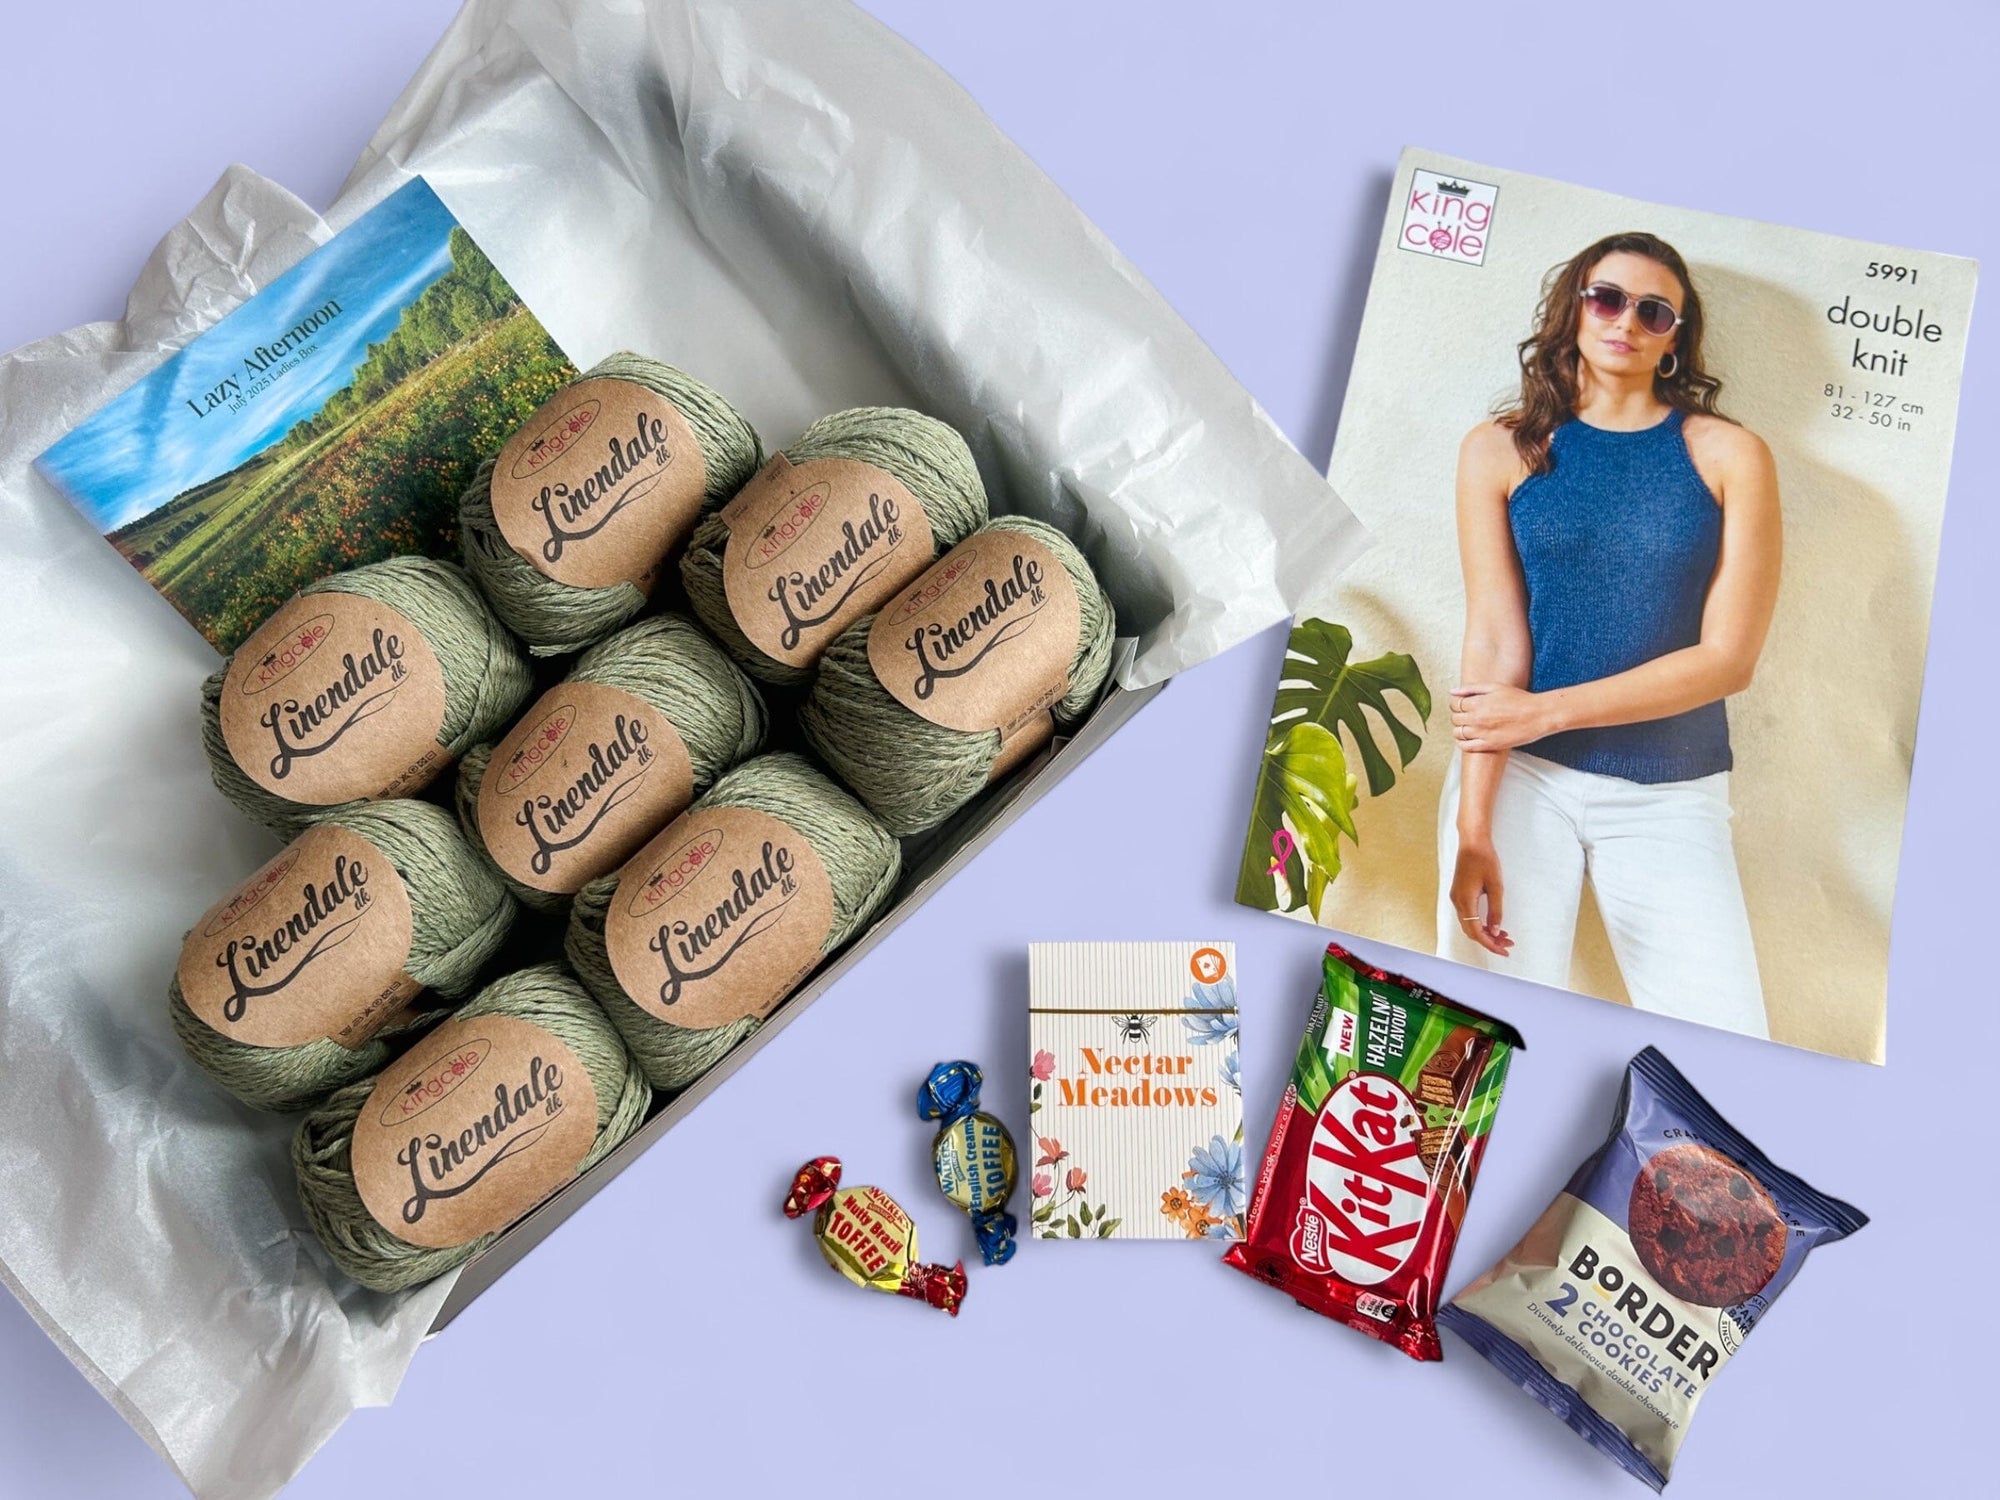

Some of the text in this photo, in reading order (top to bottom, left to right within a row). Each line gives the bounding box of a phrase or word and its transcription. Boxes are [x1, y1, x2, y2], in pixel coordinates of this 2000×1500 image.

[1865, 262, 1918, 285] 5991
[185, 300, 344, 419] Lazy Afternoon
[1827, 295, 1942, 343] double
[1852, 337, 1908, 377] knit
[228, 342, 320, 416] July 2025 Ladies Box
[1823, 383, 1844, 399] 81
[1864, 391, 1897, 408] 127
[1901, 401, 1924, 415] cm
[1830, 403, 1854, 420] 32
[1868, 411, 1893, 428] 50
[1897, 417, 1911, 432] in
[532, 412, 668, 563] Linendale
[768, 493, 900, 650] Linendale
[905, 554, 1044, 700] Linendale
[260, 627, 405, 780] Linendale
[515, 713, 648, 875] Linendale
[216, 855, 368, 1022] Linendale
[649, 841, 794, 1006] Linendale
[1078, 1046, 1194, 1076] Nectar
[1339, 1013, 1354, 1053] NEW
[1057, 1077, 1219, 1108] Meadows
[397, 1056, 563, 1224] Linendale
[982, 1125, 1008, 1198] TOFFEE
[1248, 1196, 1263, 1225] Have
[1271, 1124, 1285, 1147] have
[1310, 1080, 1428, 1272] KitKat
[842, 1194, 873, 1227] Nutty
[869, 1220, 904, 1256] Brazil
[967, 1163, 983, 1210] English
[829, 1211, 887, 1274] TOFFEE
[1545, 1282, 1698, 1399] 2 CHOCOLATE
[1568, 1244, 1719, 1381] BORDER
[1526, 1302, 1681, 1431] Divinely delicious double chocolate
[1577, 1321, 1664, 1394] COOKIES
